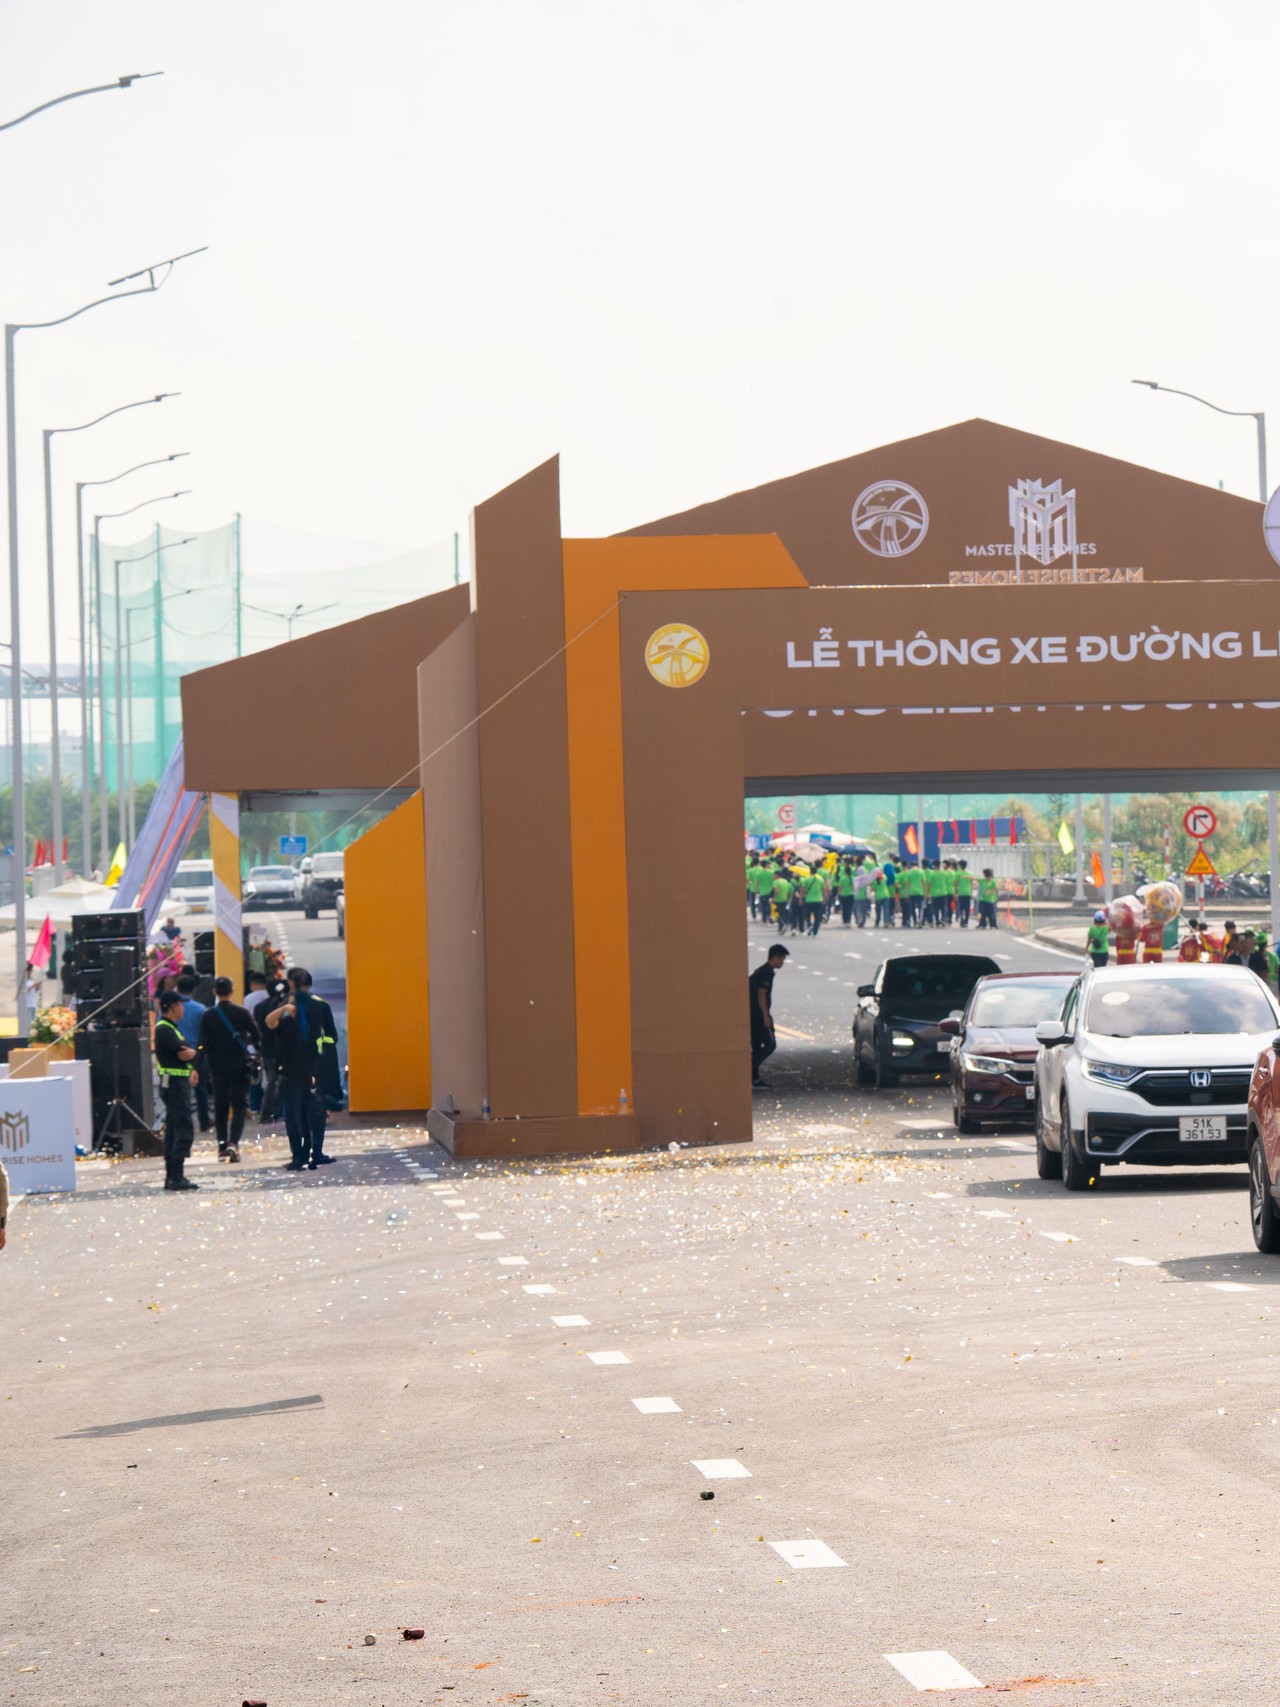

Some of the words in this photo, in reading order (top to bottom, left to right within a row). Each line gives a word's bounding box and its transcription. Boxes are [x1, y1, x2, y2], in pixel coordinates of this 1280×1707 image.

[786, 627, 840, 668] LỄ
[847, 630, 1001, 667] THÔNG
[1010, 636, 1068, 664] XE
[1076, 625, 1243, 662] ĐƯỜNG
[1193, 1118, 1212, 1128] 51K
[1185, 1129, 1222, 1139] 361.53
[26, 1154, 63, 1163] HOMES
